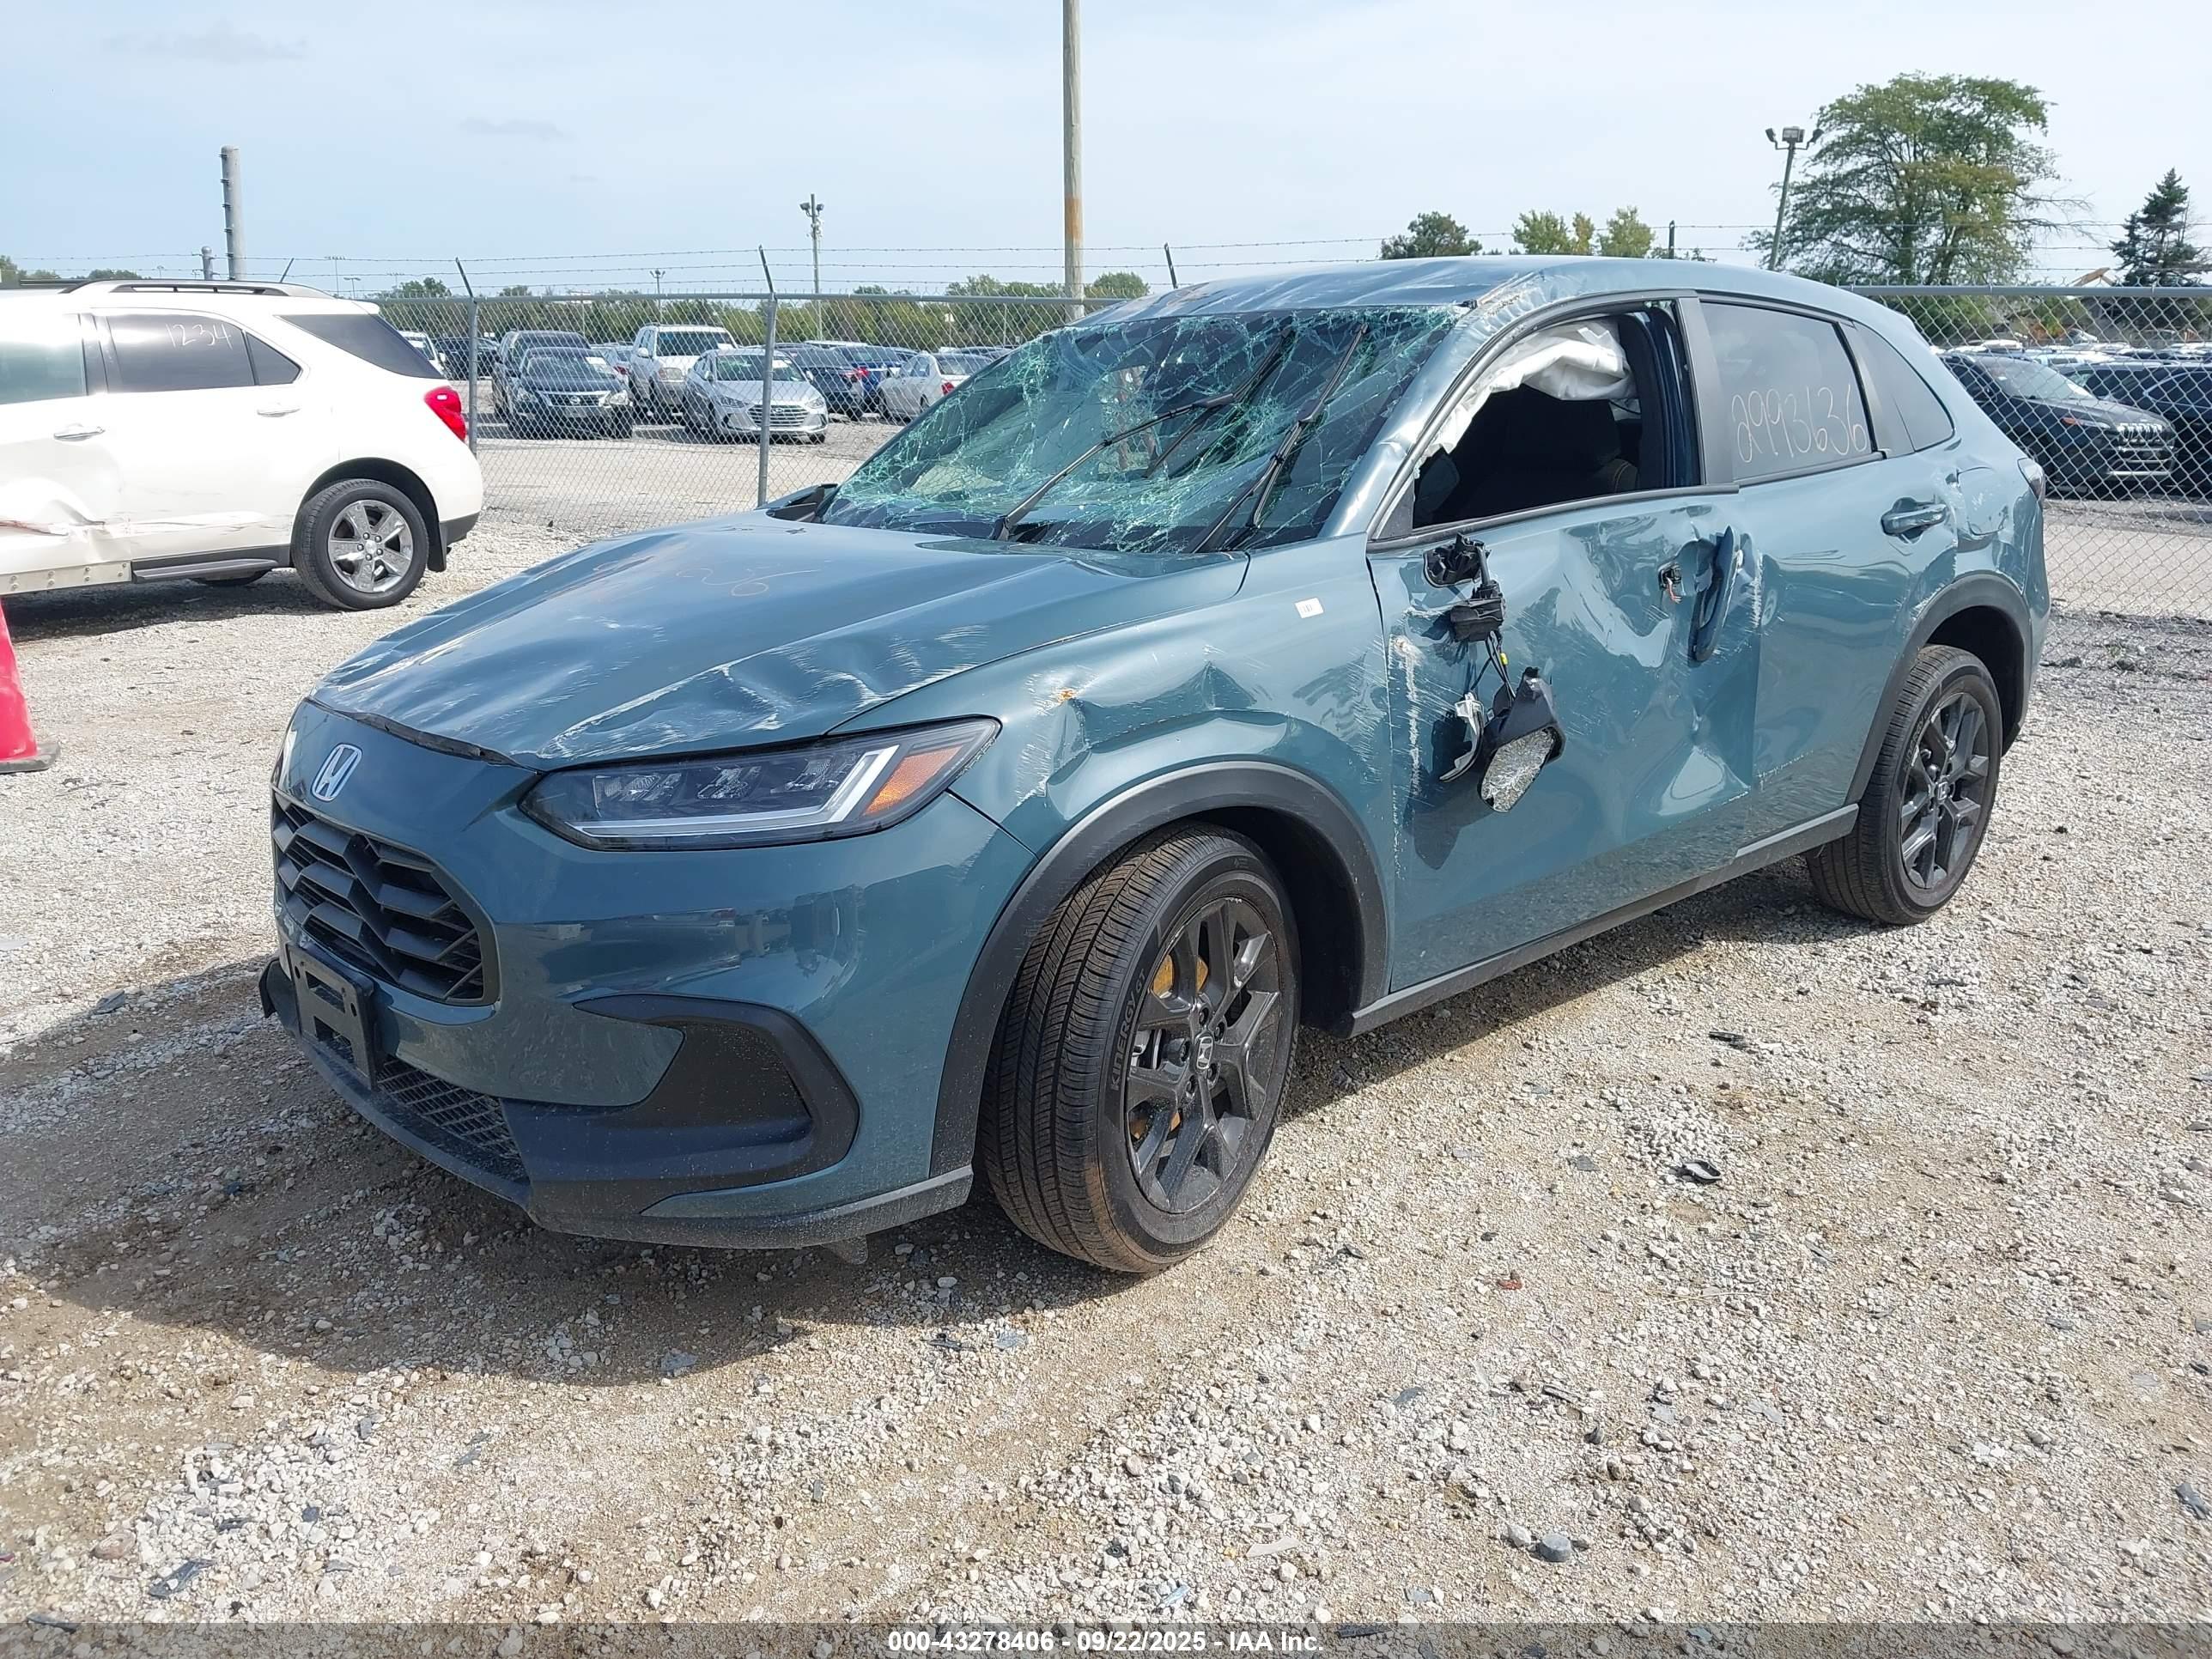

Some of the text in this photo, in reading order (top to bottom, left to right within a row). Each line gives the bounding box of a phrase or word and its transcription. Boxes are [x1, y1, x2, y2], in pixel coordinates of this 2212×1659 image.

[165, 322, 234, 350] 1234
[1731, 384, 1869, 464] 2993636
[1110, 968, 1146, 1091] KINERGY GT
